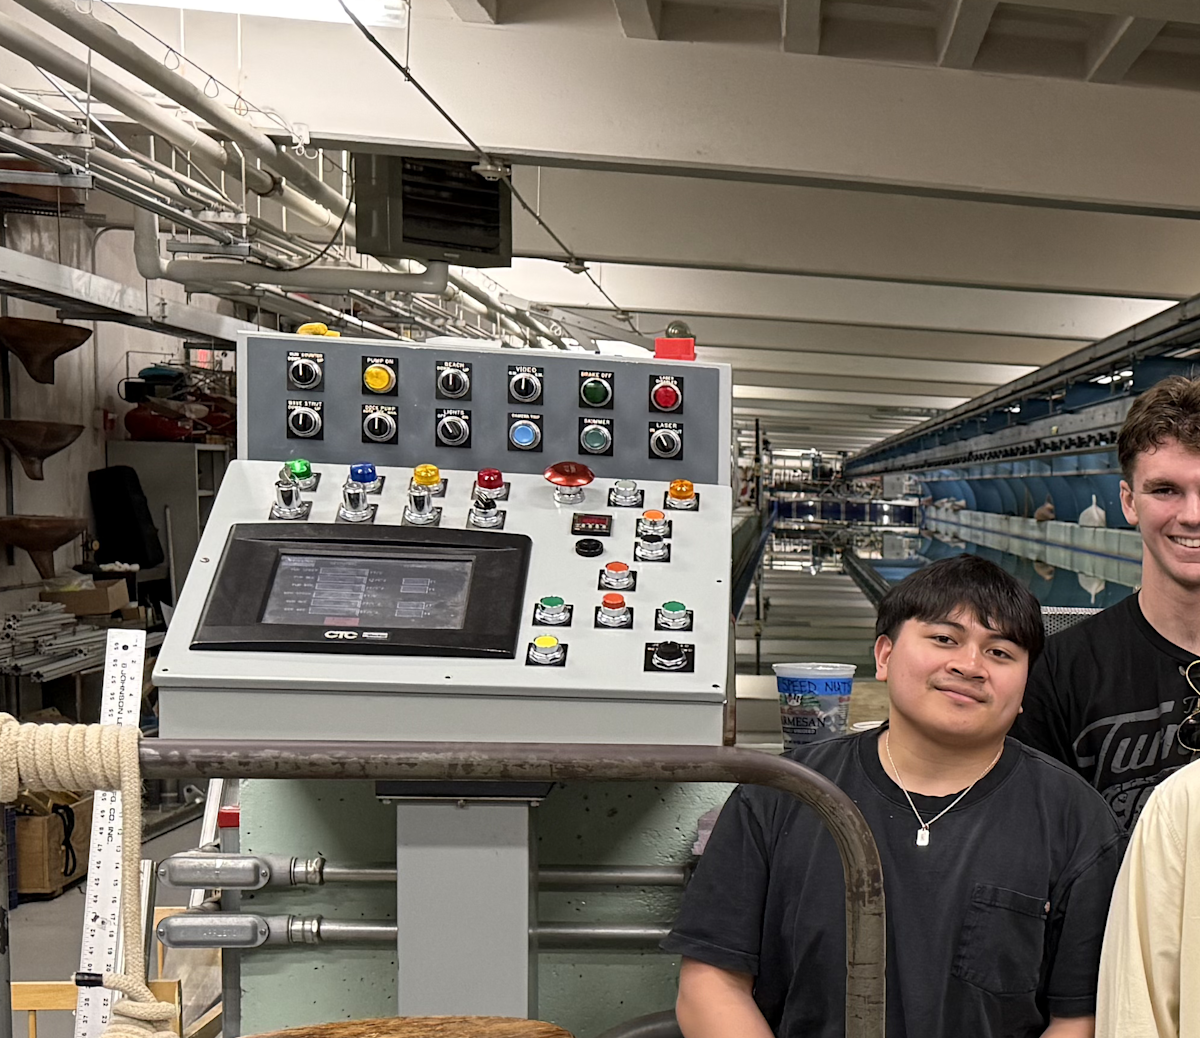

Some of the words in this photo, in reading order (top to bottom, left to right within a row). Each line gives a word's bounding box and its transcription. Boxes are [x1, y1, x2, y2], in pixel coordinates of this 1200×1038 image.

[324, 630, 359, 640] CTC
[117, 669, 127, 715] JOHNSON
[106, 826, 114, 845] INC.
